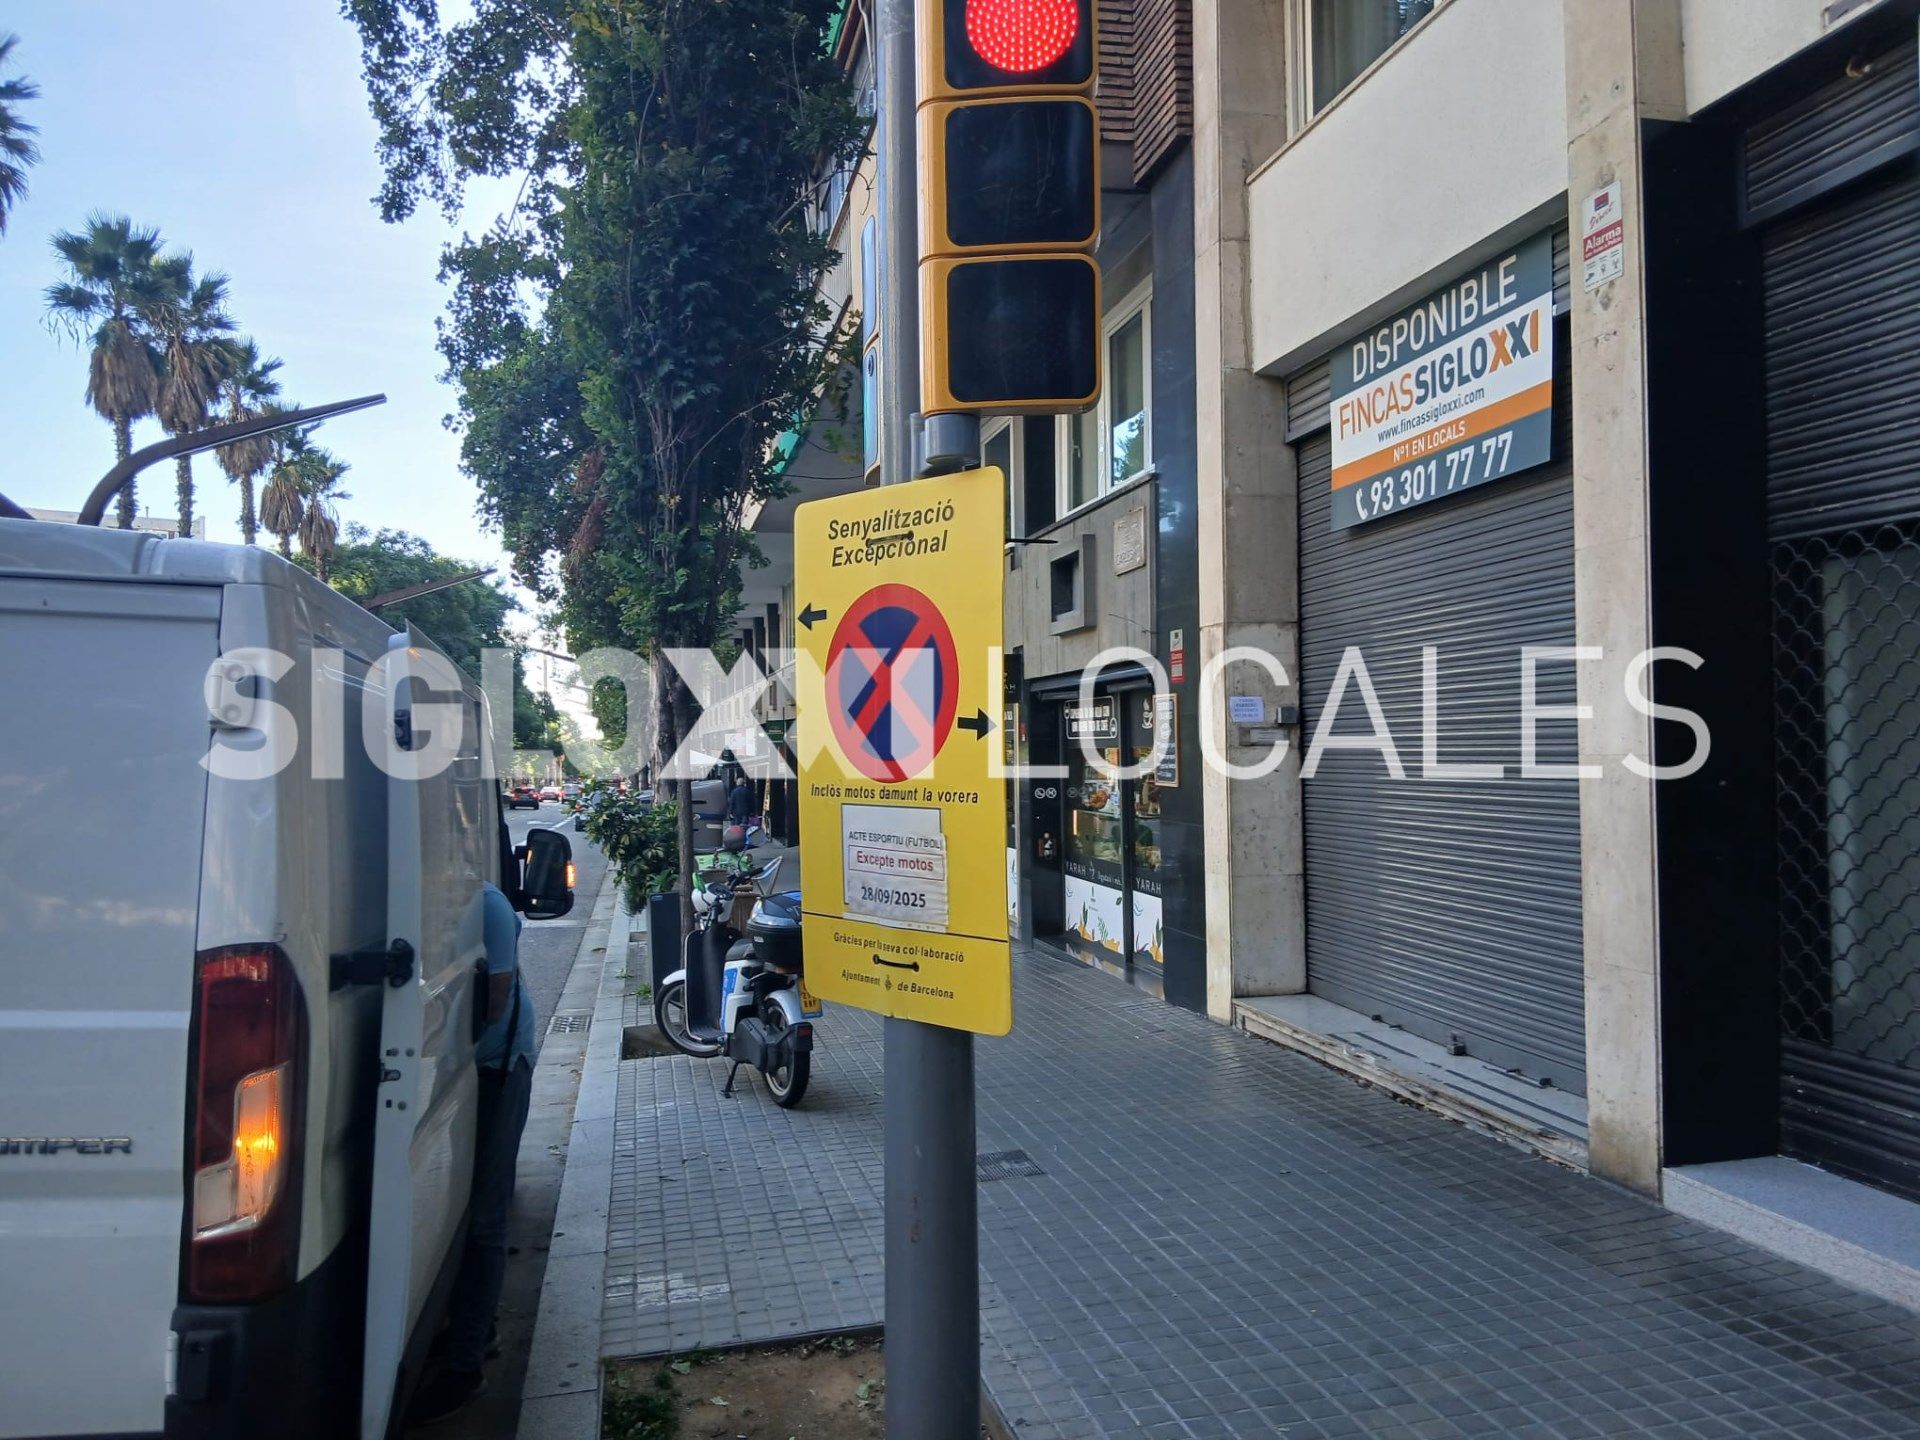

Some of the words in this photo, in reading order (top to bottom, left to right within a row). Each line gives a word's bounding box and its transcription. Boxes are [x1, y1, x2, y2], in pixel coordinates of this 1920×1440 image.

[1585, 226, 1622, 252] Alarma
[1352, 254, 1518, 383] DISPONIBLE
[1377, 386, 1486, 443] www.fincassigloxxi.com
[1411, 439, 1426, 457] EN
[1426, 420, 1467, 450] LOCALS
[1370, 476, 1395, 516] 93
[1400, 459, 1436, 506] 301
[1446, 446, 1475, 490] 77
[1481, 430, 1514, 478] 77
[827, 498, 955, 541] Senyalització
[831, 530, 949, 567] Excepcional
[810, 783, 842, 798] Inclòs
[844, 786, 876, 800] motos
[879, 786, 918, 801] damunt
[922, 787, 933, 801] la
[937, 791, 979, 804] vorera
[849, 831, 867, 842] ACTE
[868, 833, 904, 846] ESPORTIU
[856, 850, 895, 870] Excepte
[898, 858, 934, 872] motos
[860, 886, 927, 908] 28/09/2025
[1135, 877, 1162, 895] YARAH
[833, 932, 863, 947] Gràcies
[863, 938, 877, 950] per
[882, 942, 901, 954] seva
[841, 969, 881, 987] Ajuntament
[896, 980, 909, 992] de
[910, 982, 954, 1000] Barcelona
